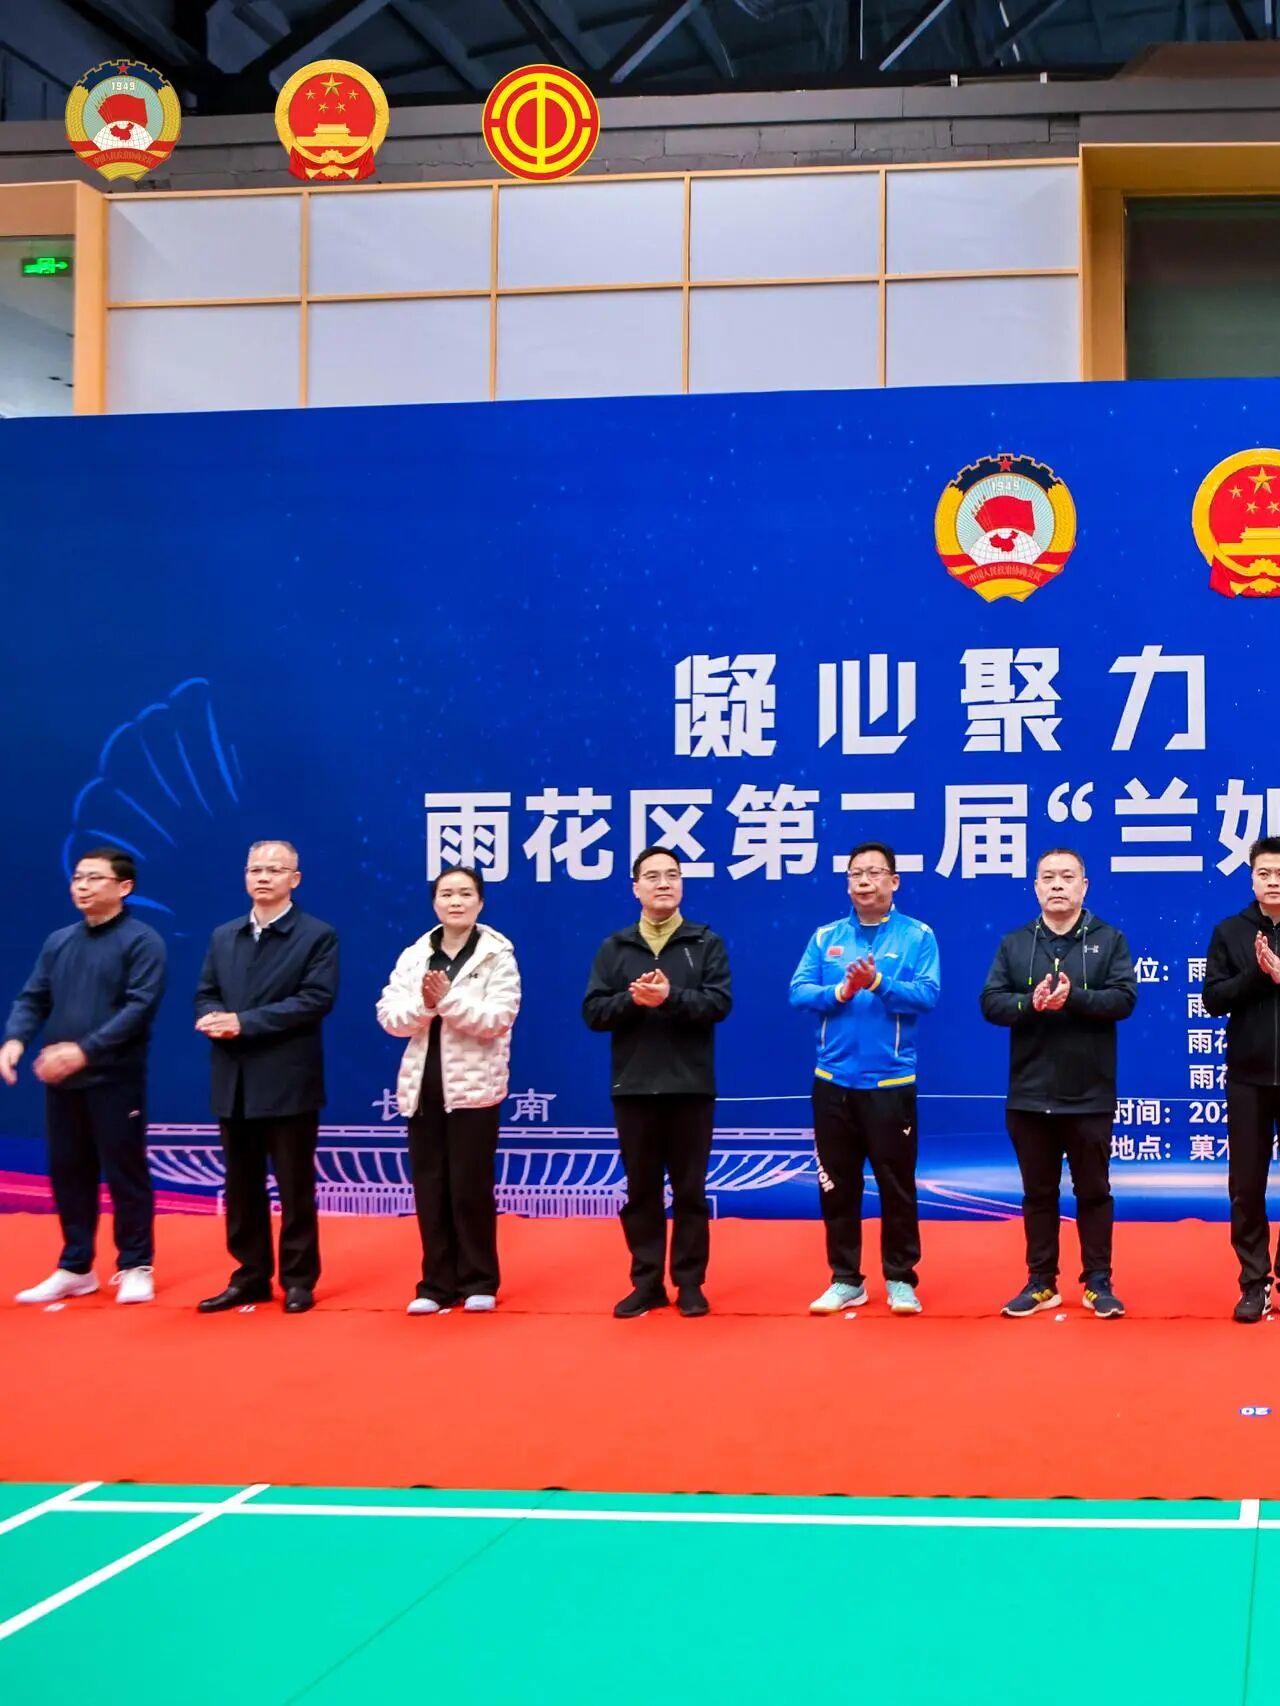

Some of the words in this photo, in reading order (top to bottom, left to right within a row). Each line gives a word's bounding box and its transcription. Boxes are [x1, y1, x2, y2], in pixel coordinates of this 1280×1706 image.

[991, 480, 1020, 491] 1949
[674, 645, 1207, 758] 凝心聚力
[508, 1088, 557, 1122] 南
